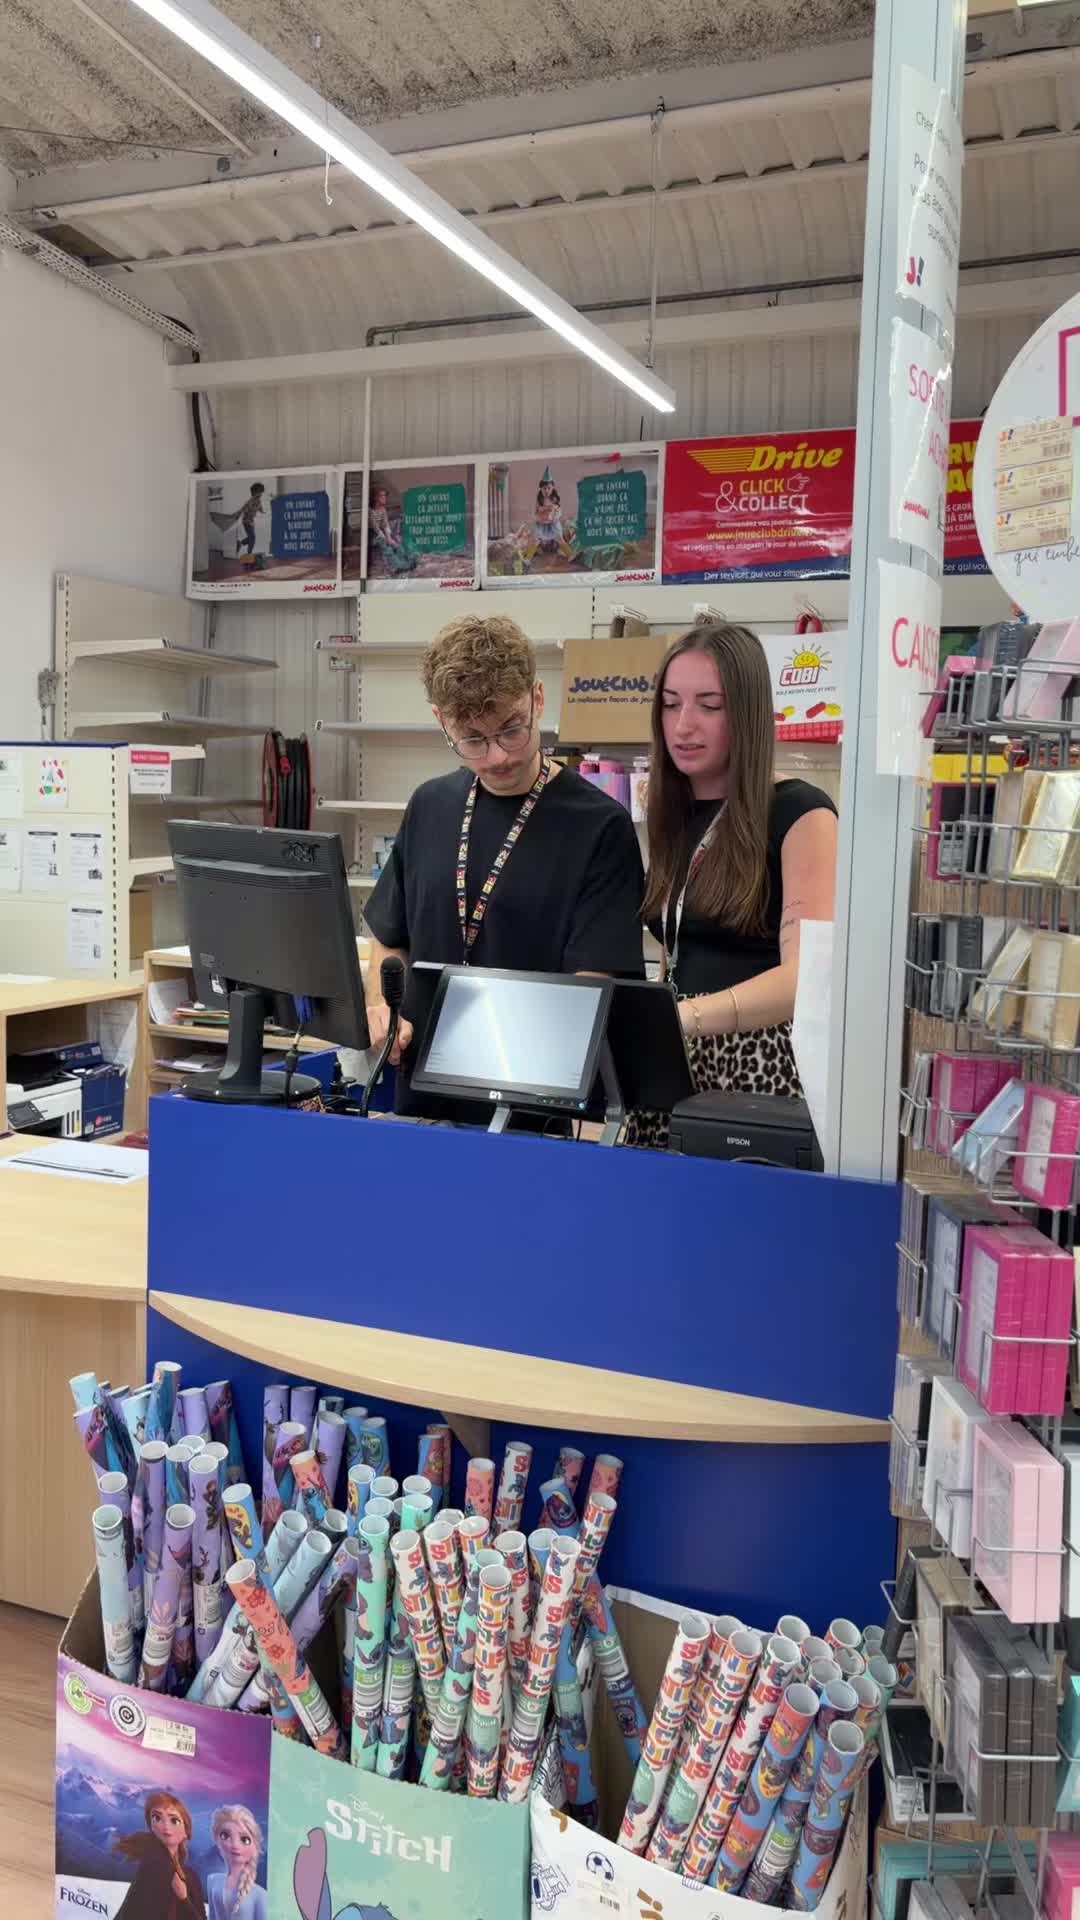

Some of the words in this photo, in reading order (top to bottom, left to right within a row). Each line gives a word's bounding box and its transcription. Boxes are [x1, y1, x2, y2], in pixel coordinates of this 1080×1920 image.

[747, 443, 843, 472] Drive
[715, 481, 738, 513] &
[739, 478, 785, 496] CLICK
[739, 494, 809, 512] COLLECT
[720, 569, 748, 580] services
[750, 569, 763, 580] qui
[764, 568, 782, 578] vous
[781, 667, 820, 686] COBI
[726, 1136, 751, 1146] EPSON
[323, 1799, 455, 1873] STITCH
[60, 1885, 109, 1918] FROZEN
